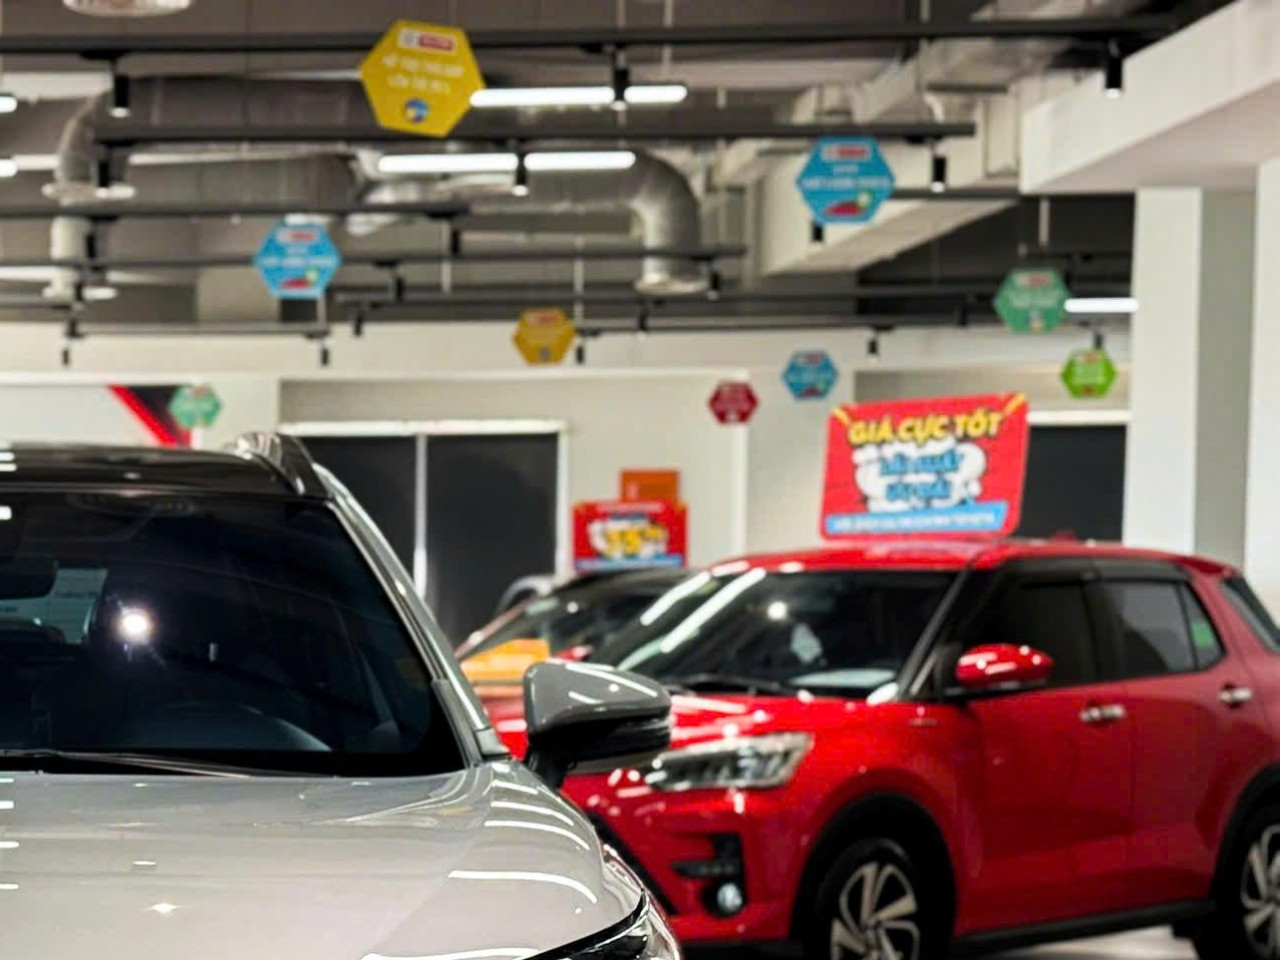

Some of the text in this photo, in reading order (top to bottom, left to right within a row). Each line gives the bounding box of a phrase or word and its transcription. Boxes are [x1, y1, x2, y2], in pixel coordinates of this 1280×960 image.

[848, 407, 1002, 446] GIÁ CỰC TỐT
